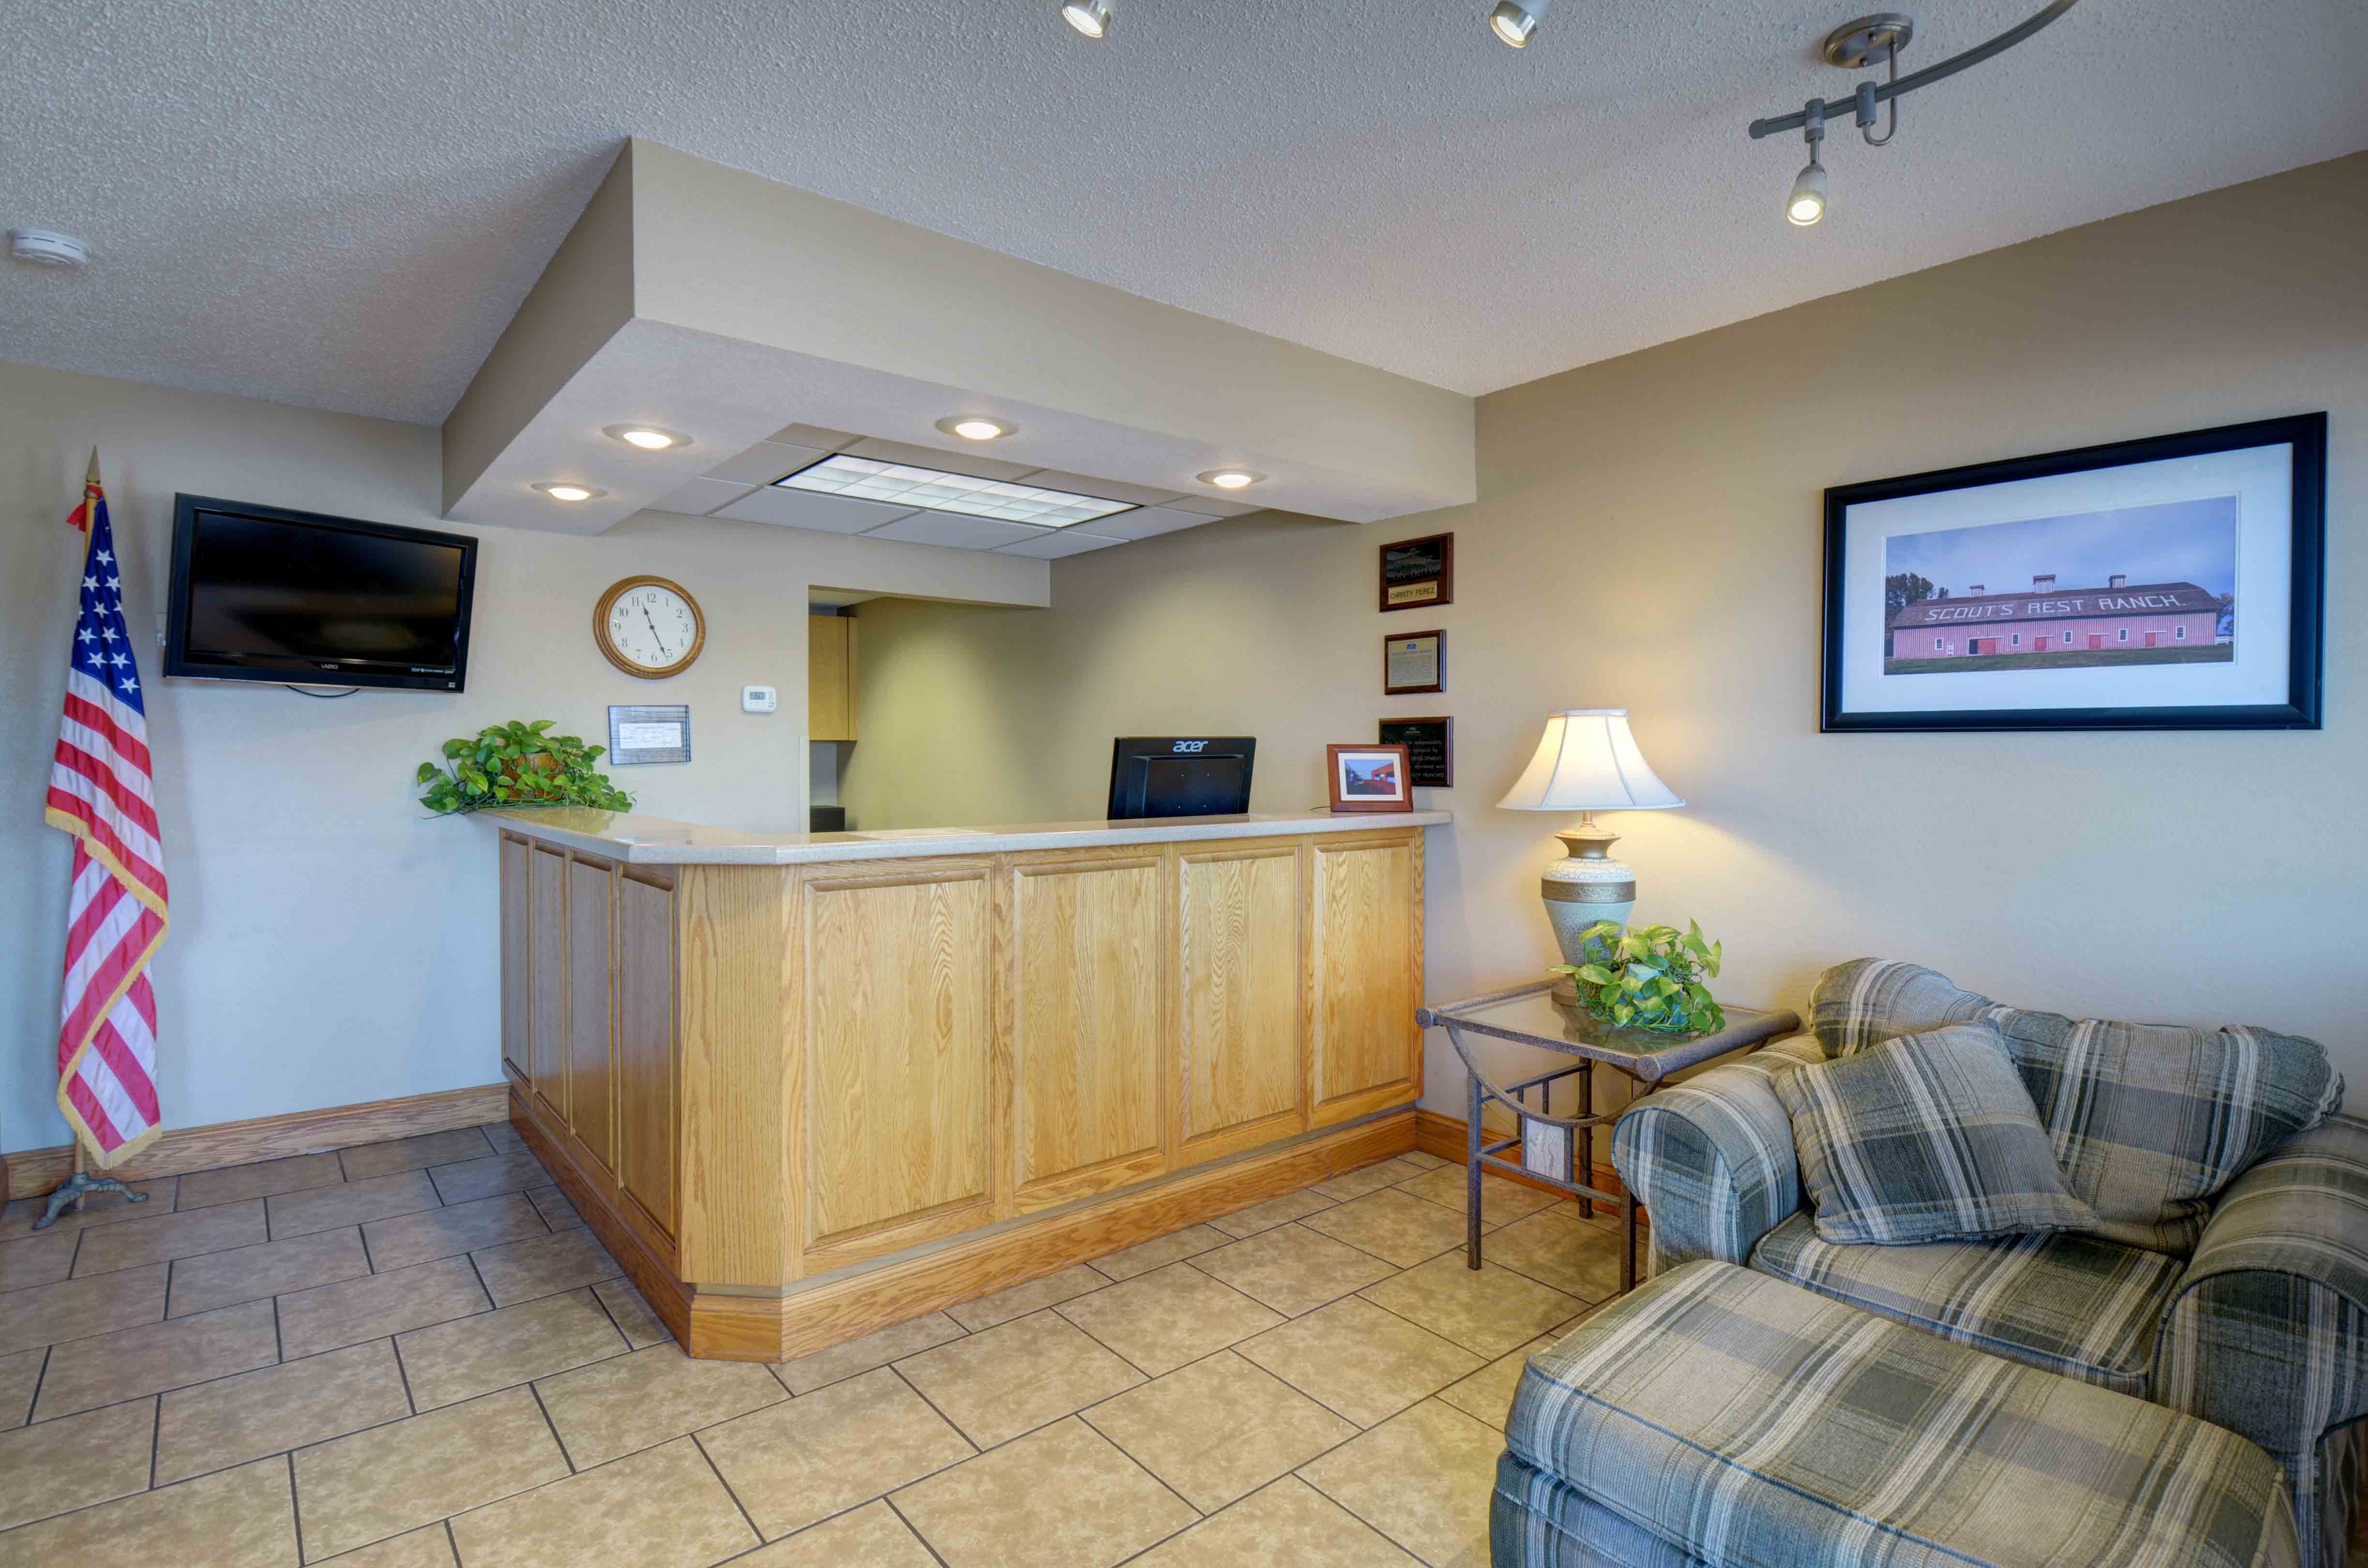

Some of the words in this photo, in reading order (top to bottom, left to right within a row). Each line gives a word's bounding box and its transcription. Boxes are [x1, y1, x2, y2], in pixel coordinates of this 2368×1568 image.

[647, 592, 657, 603] 12
[1390, 591, 1413, 599] CHRISTY
[1416, 587, 1434, 596] PEREZ
[632, 597, 639, 606] 11
[619, 607, 628, 617] 10
[676, 608, 683, 618] 2
[1924, 604, 2013, 621] SCOUT'S
[2028, 600, 2085, 614] REST
[615, 622, 621, 631] 9
[682, 623, 688, 633] 3
[622, 638, 628, 647] 8
[651, 653, 657, 662] 6
[1173, 740, 1208, 753] acer
